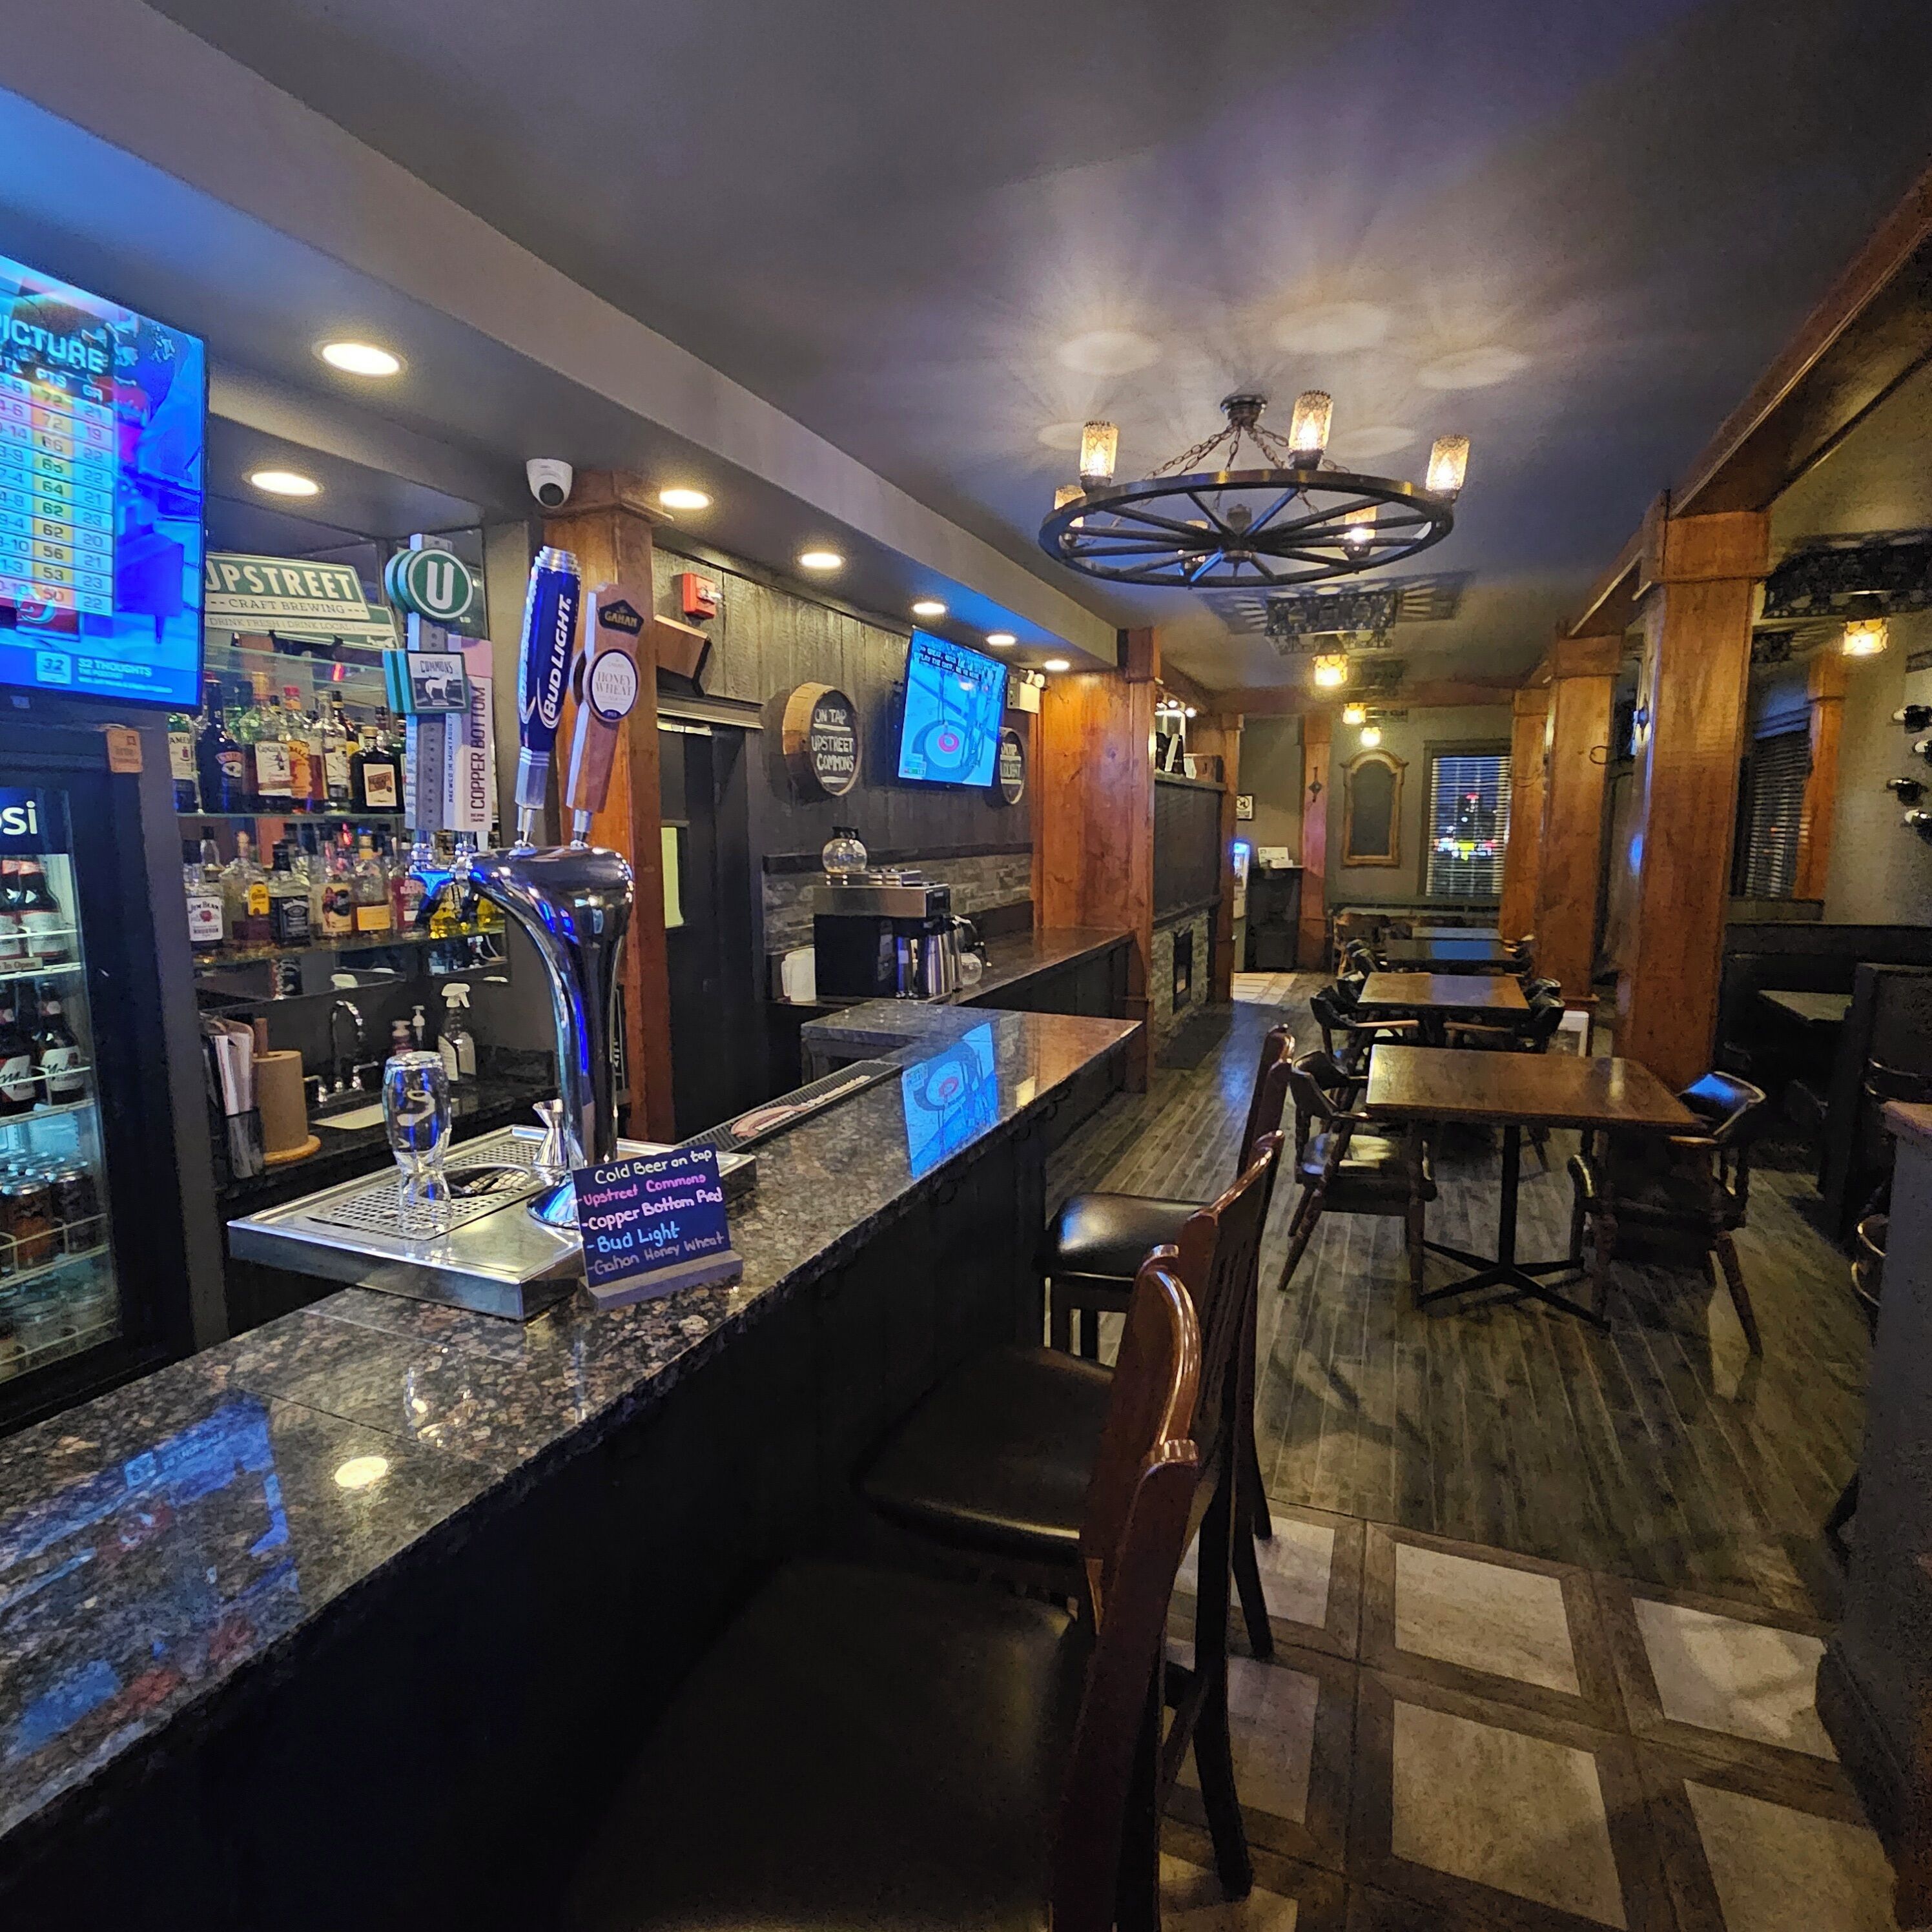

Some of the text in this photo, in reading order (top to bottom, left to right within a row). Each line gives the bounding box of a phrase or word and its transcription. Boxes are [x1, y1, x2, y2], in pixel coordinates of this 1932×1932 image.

[0, 314, 104, 374] ICTURE
[36, 367, 67, 388] PTS
[41, 390, 63, 407] 72
[84, 405, 102, 419] 21
[42, 415, 63, 430] 72
[87, 427, 102, 441] 19
[42, 436, 63, 453] 66
[42, 458, 63, 474] 65
[42, 480, 64, 496] 64
[42, 502, 64, 517] 62
[43, 524, 64, 539] 62
[83, 533, 104, 548] 20
[43, 546, 64, 560] 56
[83, 555, 102, 568] 21
[43, 567, 64, 581] 53
[83, 575, 103, 589] 23
[427, 560, 455, 610] U
[83, 596, 103, 610] 22
[228, 599, 345, 614] CRAFT BREWING
[210, 617, 245, 628] DRINK
[246, 619, 281, 629] FRESH
[287, 621, 318, 630] DRINK
[320, 622, 352, 632] LOCAL
[604, 610, 639, 627] GAHAN
[43, 657, 65, 671] 32
[543, 593, 571, 719] BUD LIGHT
[94, 659, 153, 678] THOUGHTS
[420, 660, 455, 674] COMMONS
[595, 681, 633, 696] WHEAT
[597, 671, 631, 686] HONEY
[470, 686, 486, 749] BOTTOM
[814, 708, 848, 725] ON TAP
[811, 735, 854, 753] UPSTREET
[816, 752, 854, 773] COMMONS
[470, 752, 486, 810] COPPER
[0, 800, 37, 836] si
[595, 1150, 713, 1184] Cold Beer on tap
[646, 1174, 706, 1193] Commons
[641, 1196, 695, 1217] Bottom
[637, 1220, 681, 1248] Light
[644, 1243, 681, 1261] Honey
[683, 1231, 724, 1252] Wheat
